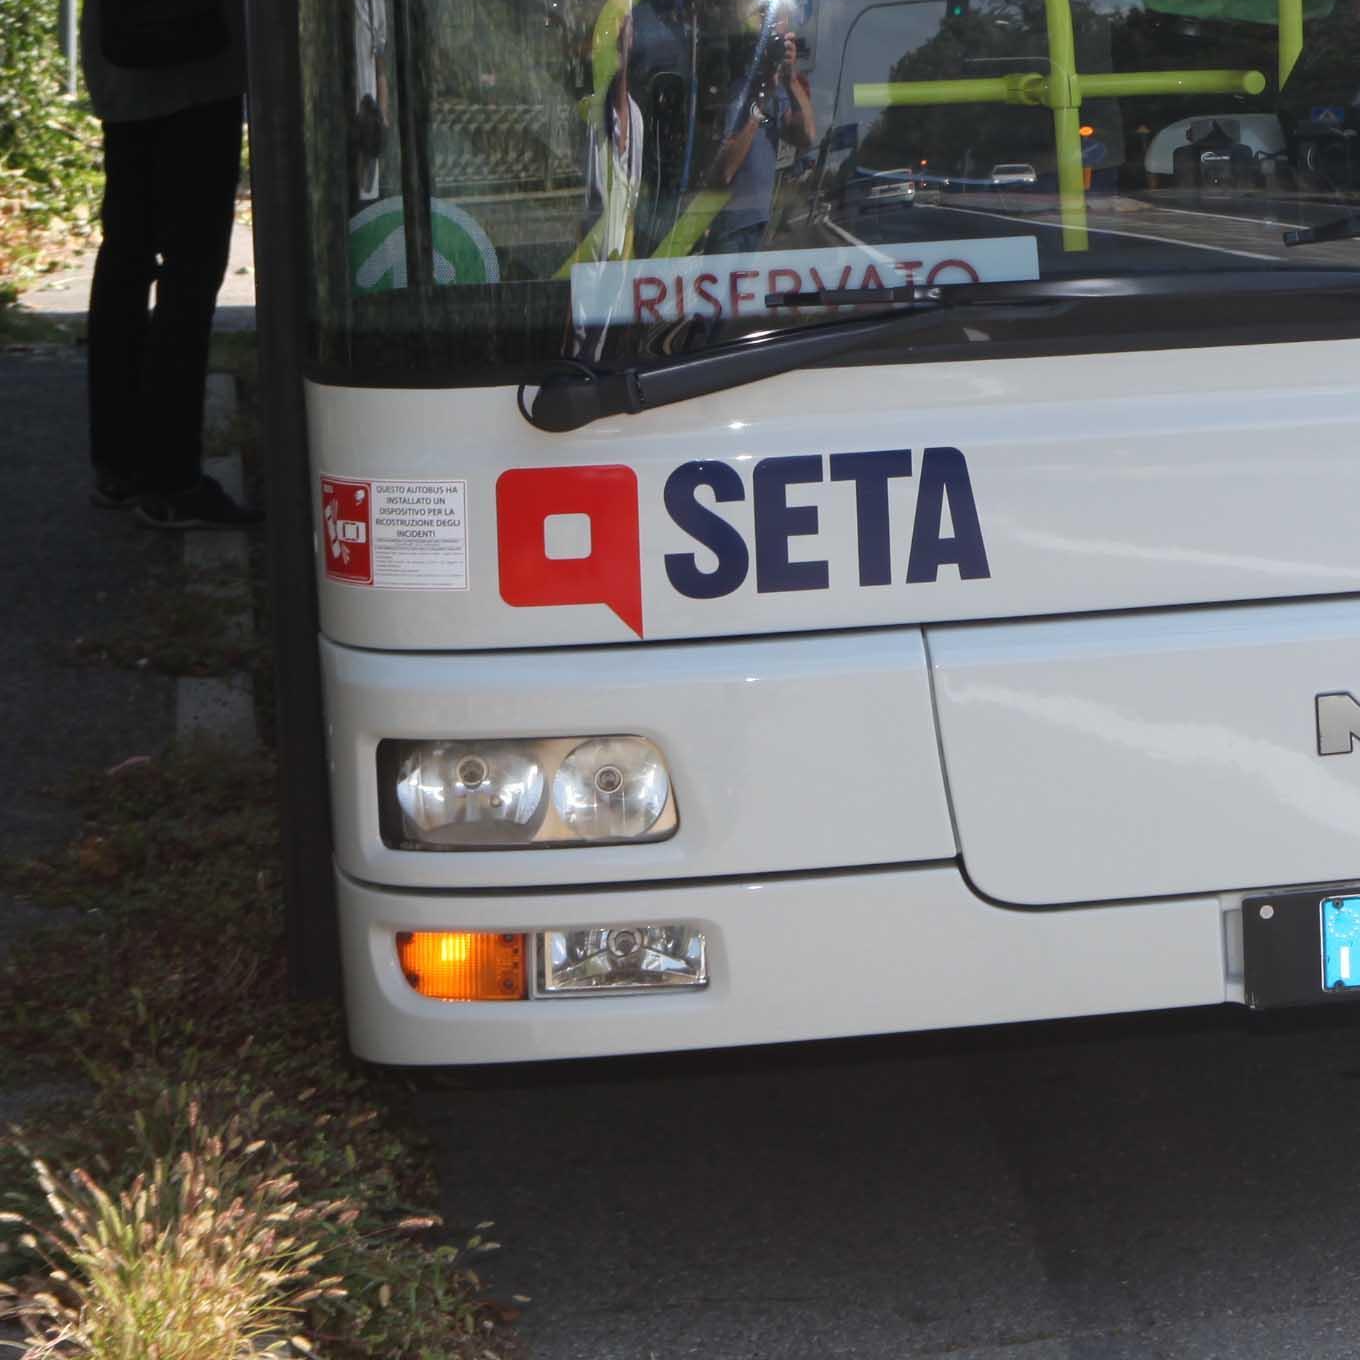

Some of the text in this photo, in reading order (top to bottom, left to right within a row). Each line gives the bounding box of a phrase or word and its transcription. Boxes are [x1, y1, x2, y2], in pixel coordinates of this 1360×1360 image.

[376, 485, 459, 494] QUESTO AUTOBUS HA
[386, 497, 446, 505] INSTALLATO UN
[379, 507, 456, 516] DISPOSITIVO PER LA
[375, 518, 461, 527] RICOSTRUZIONE DEGLI
[663, 446, 992, 600] SETA
[396, 529, 436, 538] INCIDENTI
